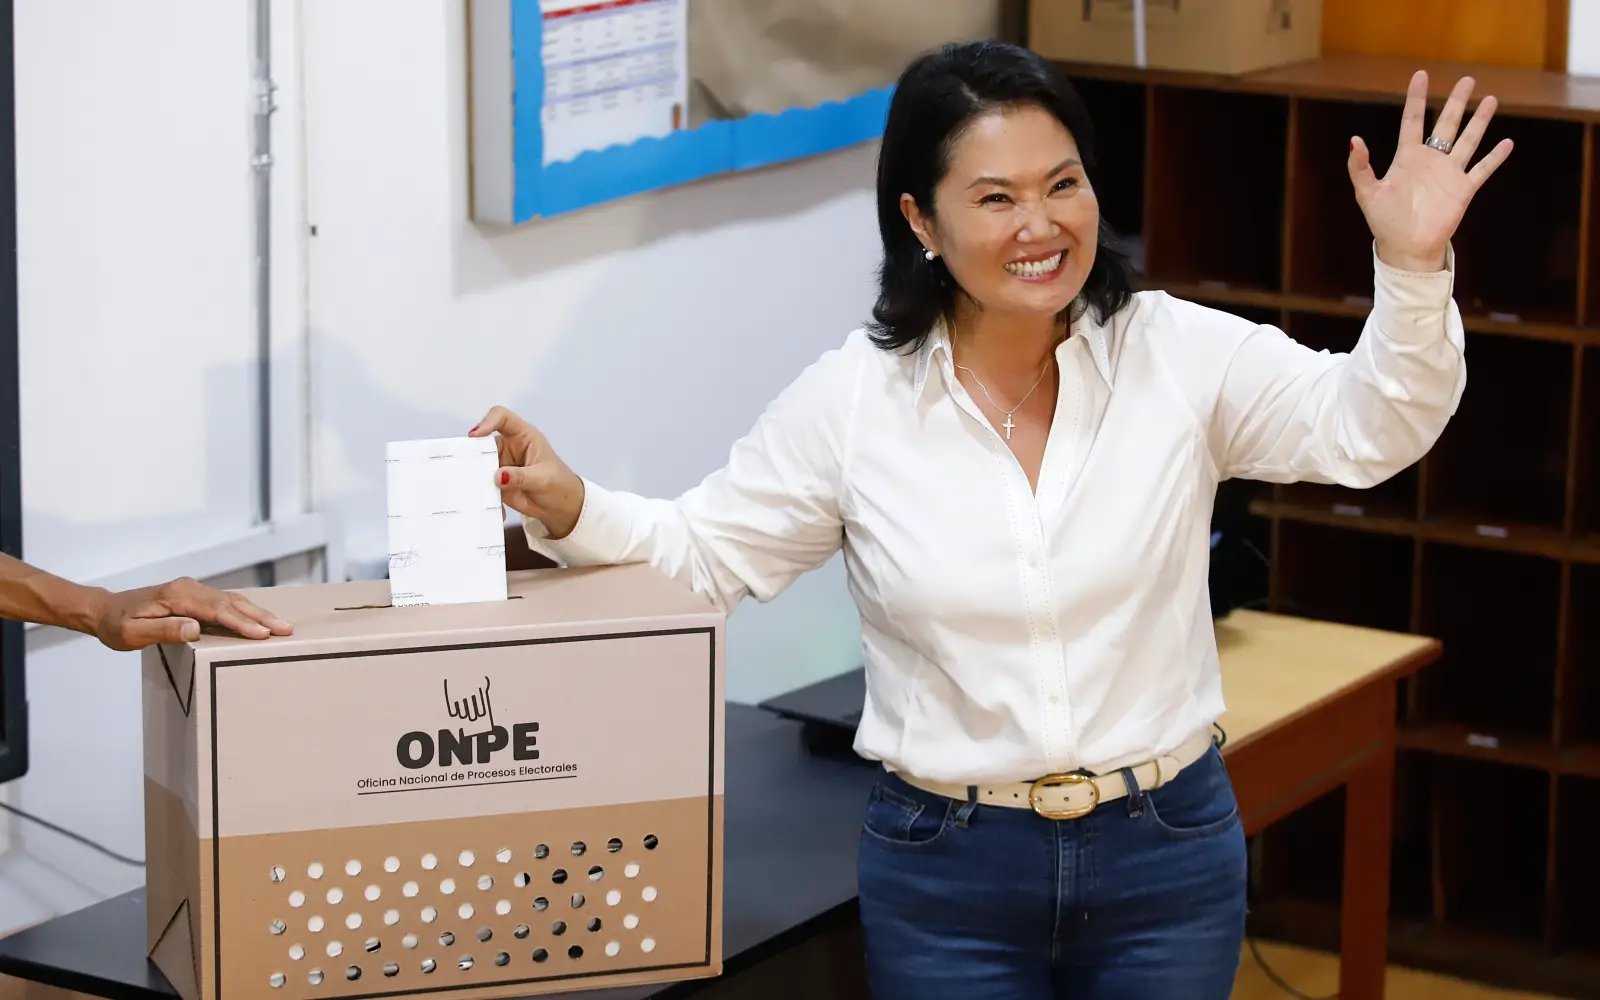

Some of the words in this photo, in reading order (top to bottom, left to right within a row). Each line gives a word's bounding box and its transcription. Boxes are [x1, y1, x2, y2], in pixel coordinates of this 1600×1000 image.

[396, 721, 540, 770] ONPE
[357, 778, 397, 789] Oficina
[399, 773, 449, 786] Nacional
[450, 772, 466, 782] de
[467, 769, 517, 780] Procesos
[519, 763, 578, 776] Electorales
